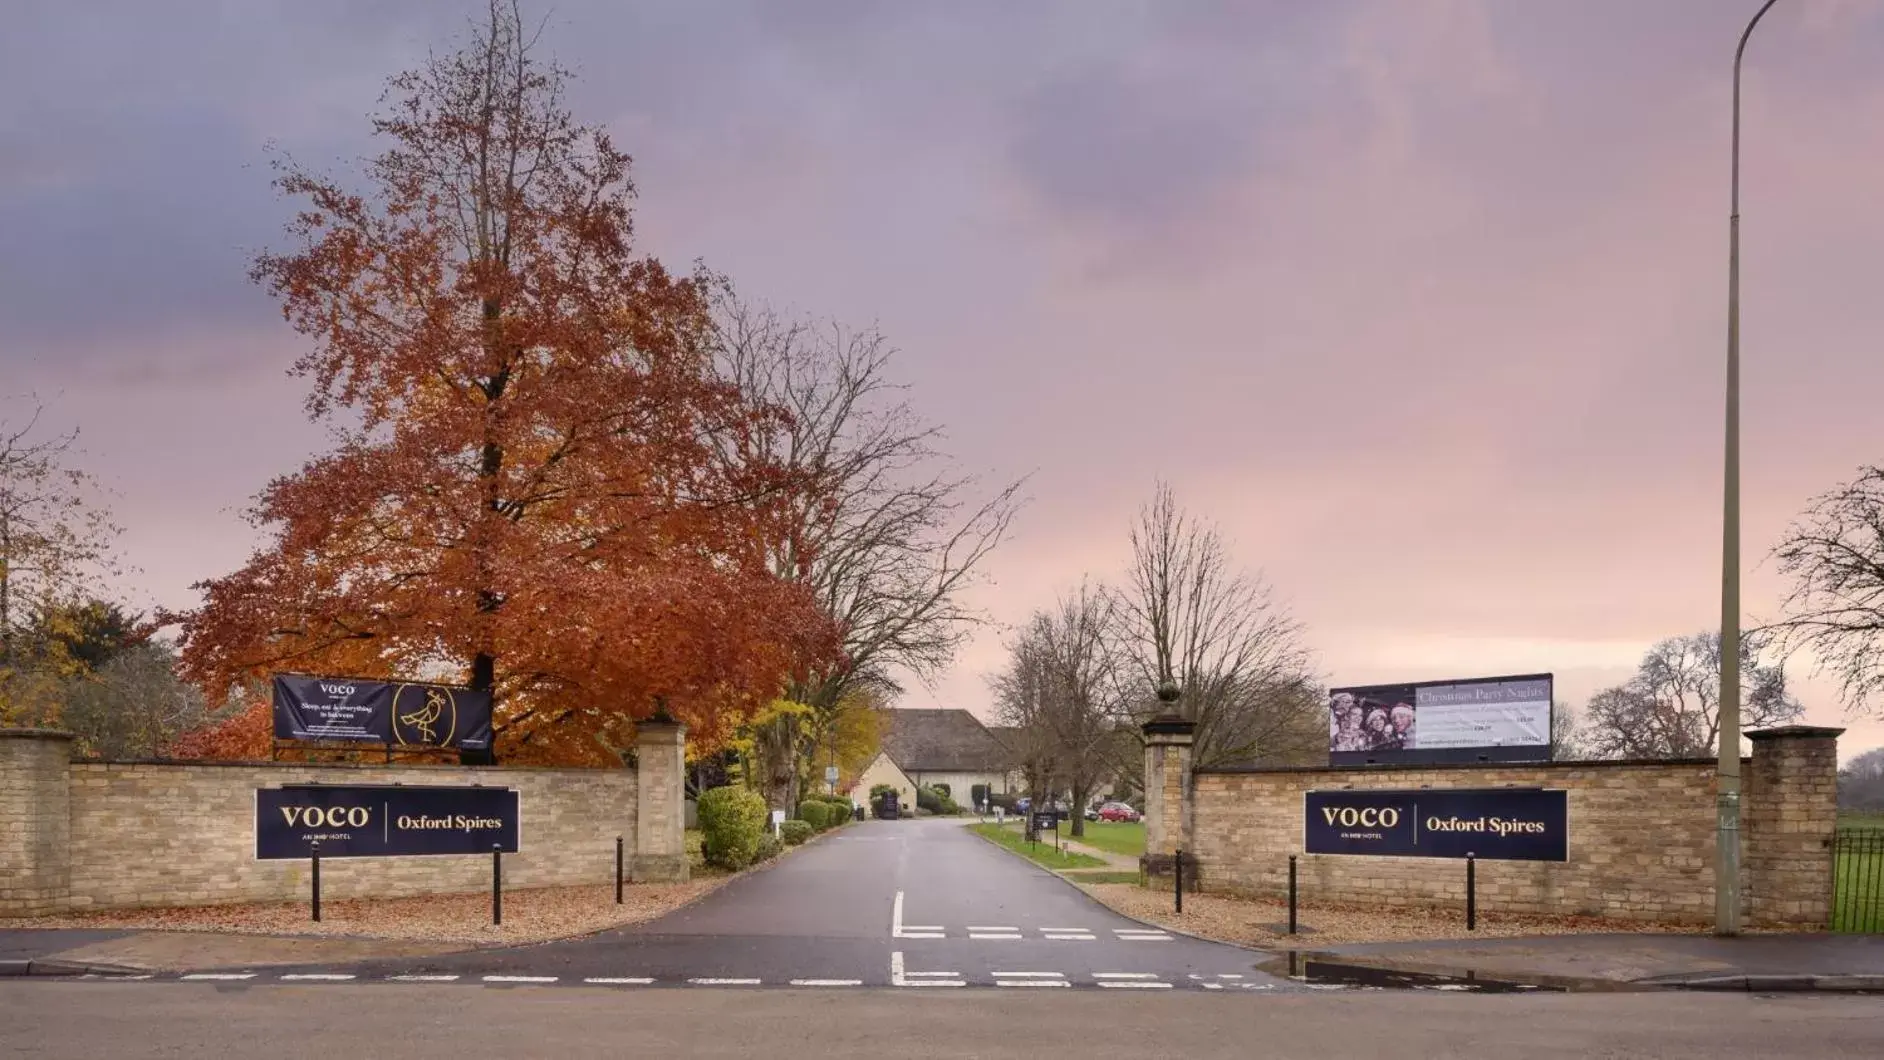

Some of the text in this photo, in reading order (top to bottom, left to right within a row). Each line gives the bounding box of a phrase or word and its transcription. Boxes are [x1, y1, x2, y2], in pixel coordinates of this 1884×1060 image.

[1475, 688, 1502, 701] Party
[397, 815, 502, 833] Oxford Spires
[1426, 816, 1545, 837] Oxford Spires
